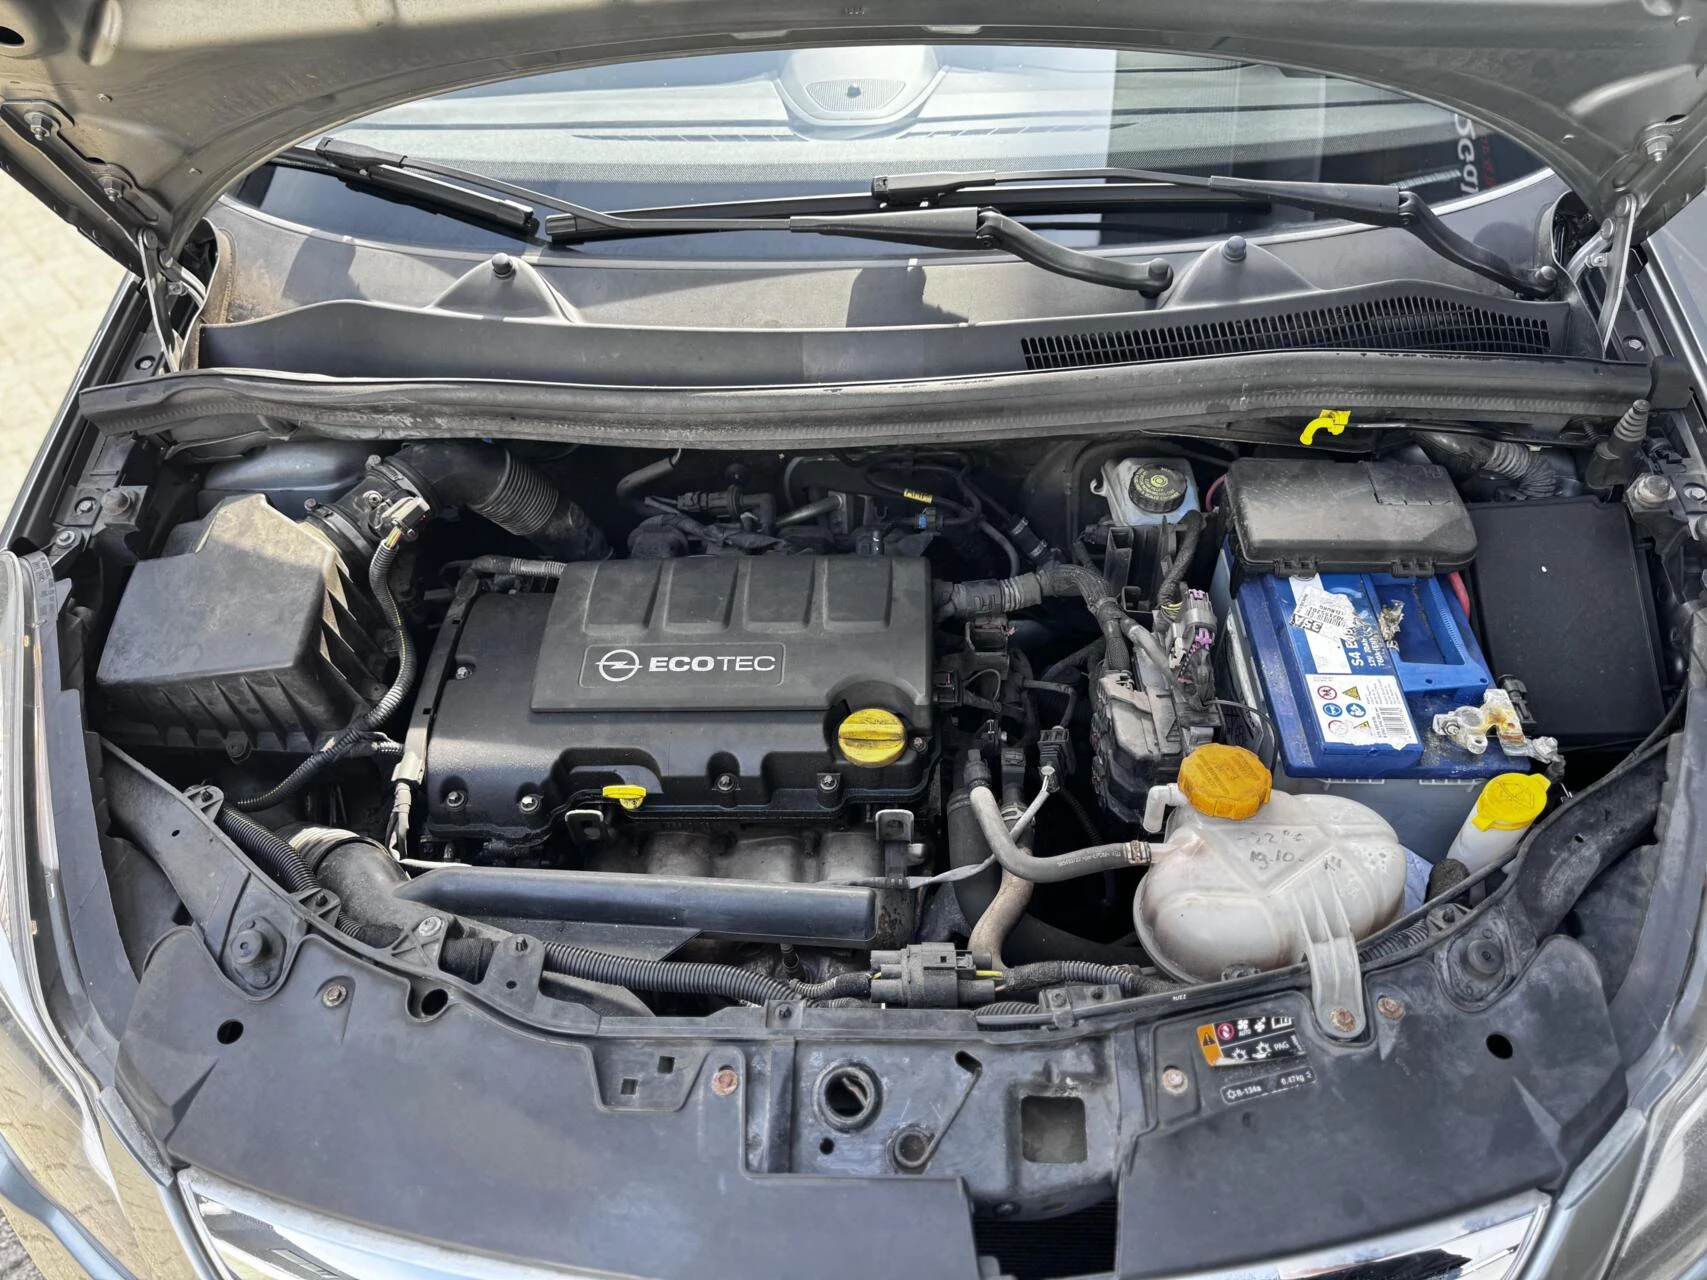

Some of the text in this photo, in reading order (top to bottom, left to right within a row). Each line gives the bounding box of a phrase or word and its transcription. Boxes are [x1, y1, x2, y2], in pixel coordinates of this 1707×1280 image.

[649, 655, 776, 672] ECOTEC
[1349, 651, 1364, 667] S4
[1238, 1028, 1252, 1037] AUTO
[1273, 1041, 1290, 1051] PAG
